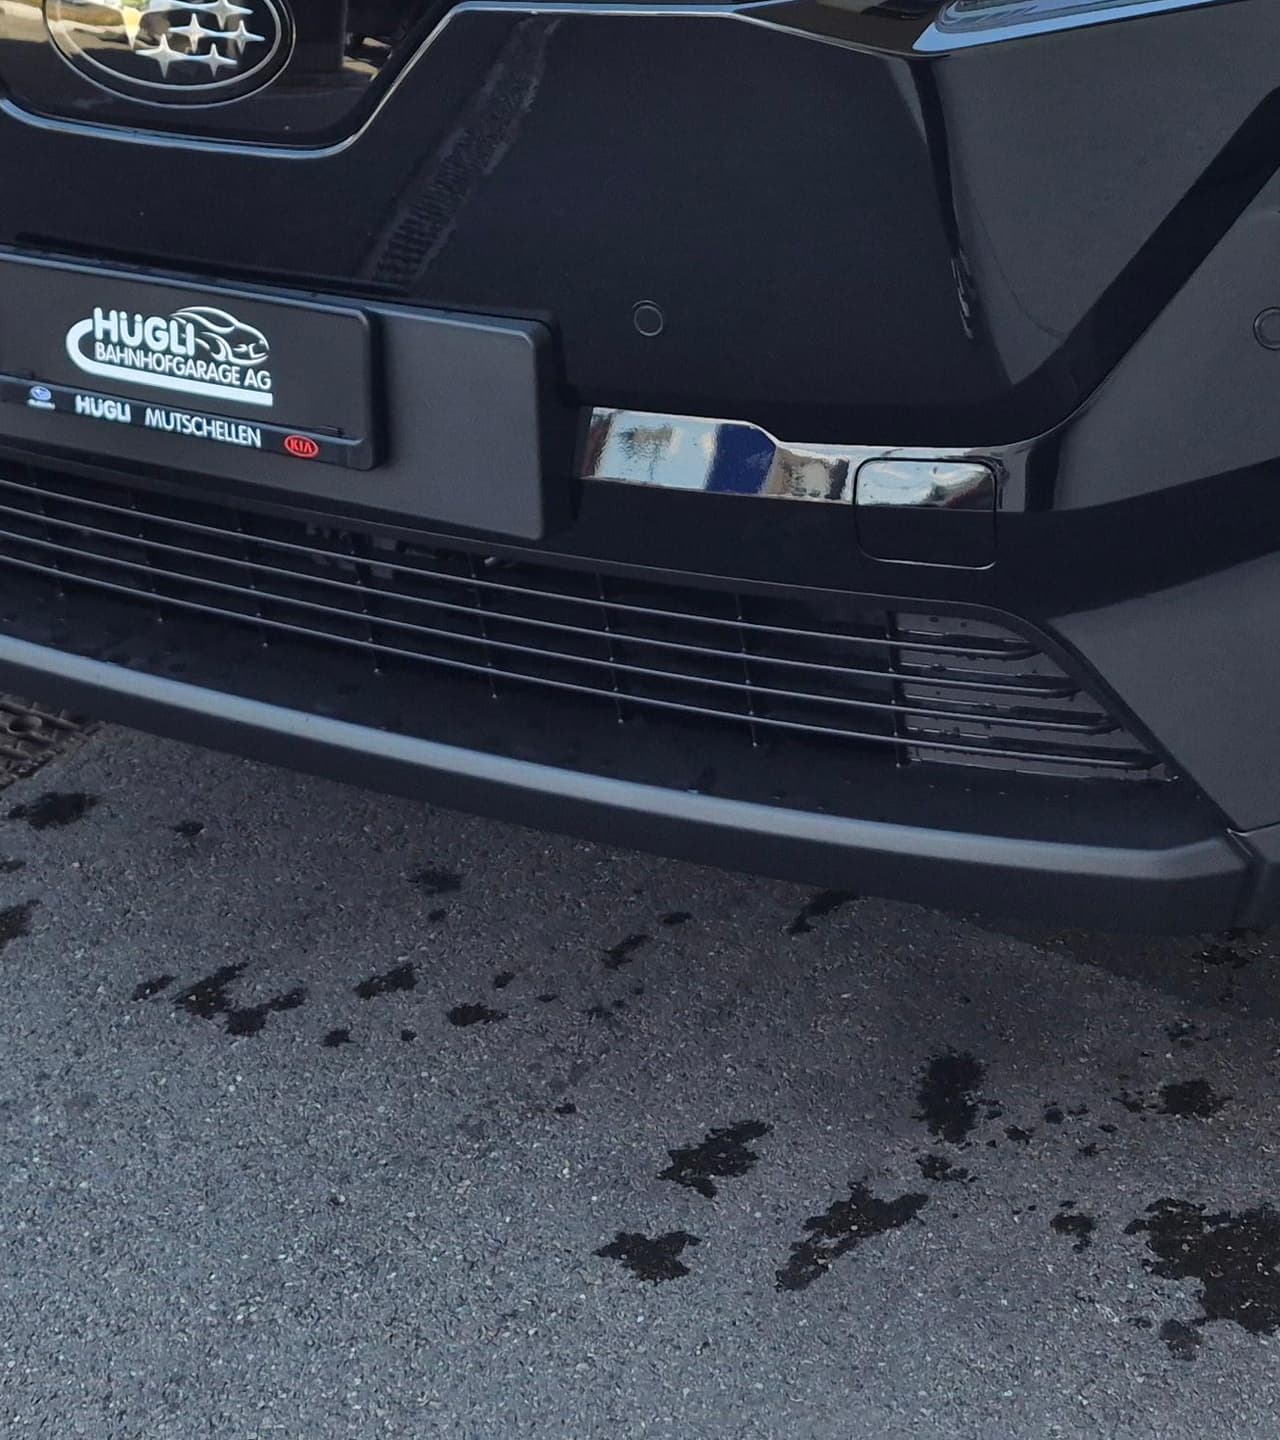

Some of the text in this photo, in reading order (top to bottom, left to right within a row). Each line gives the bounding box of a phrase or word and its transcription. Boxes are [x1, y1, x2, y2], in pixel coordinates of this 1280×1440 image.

[92, 306, 195, 357] HÜGLI
[94, 341, 272, 391] BAHNHOFGARAGE AG
[145, 407, 261, 449] MUTSCHELLEN
